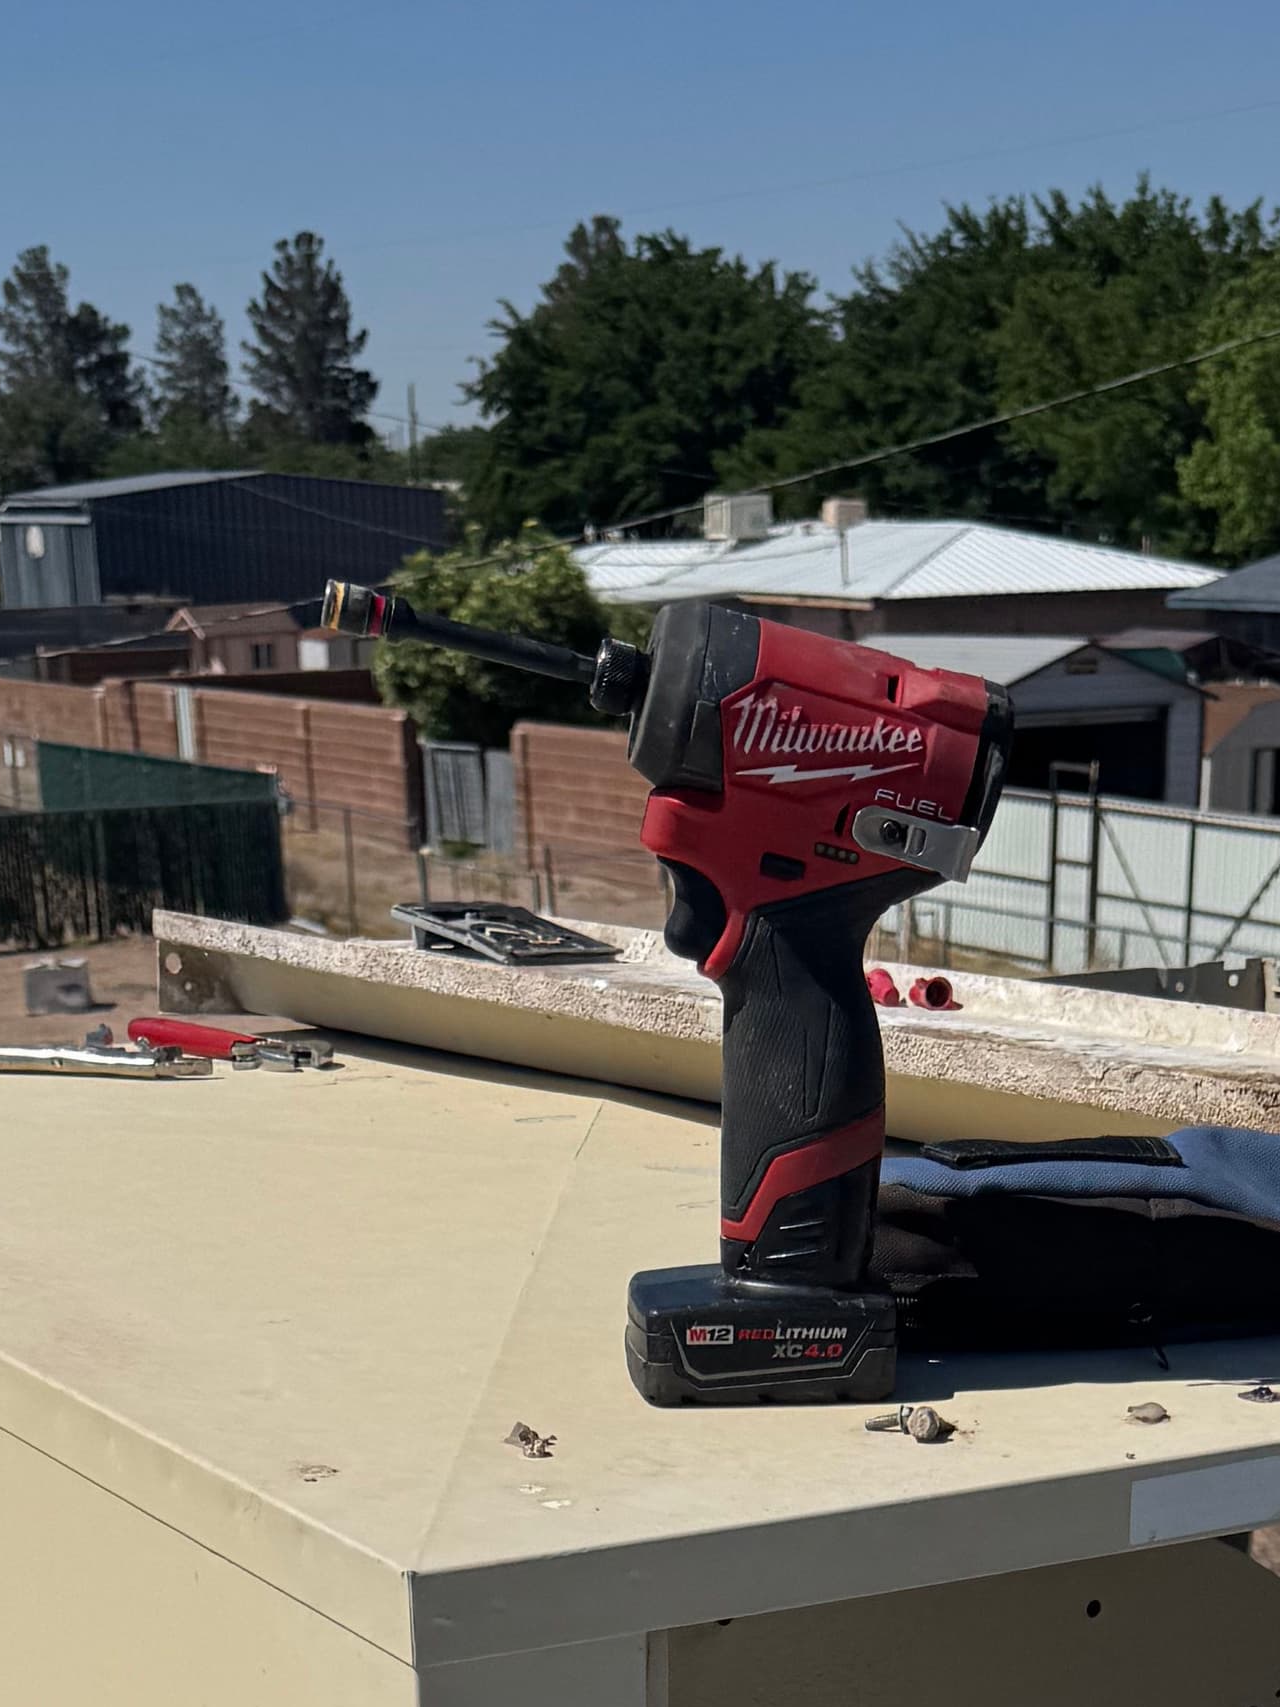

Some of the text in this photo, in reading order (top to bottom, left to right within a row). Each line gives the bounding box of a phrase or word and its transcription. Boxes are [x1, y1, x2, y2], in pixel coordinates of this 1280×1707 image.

[729, 692, 924, 755] Milwaukee
[874, 788, 954, 822] FUEL
[688, 1326, 848, 1343] M12 REDLITHIUM
